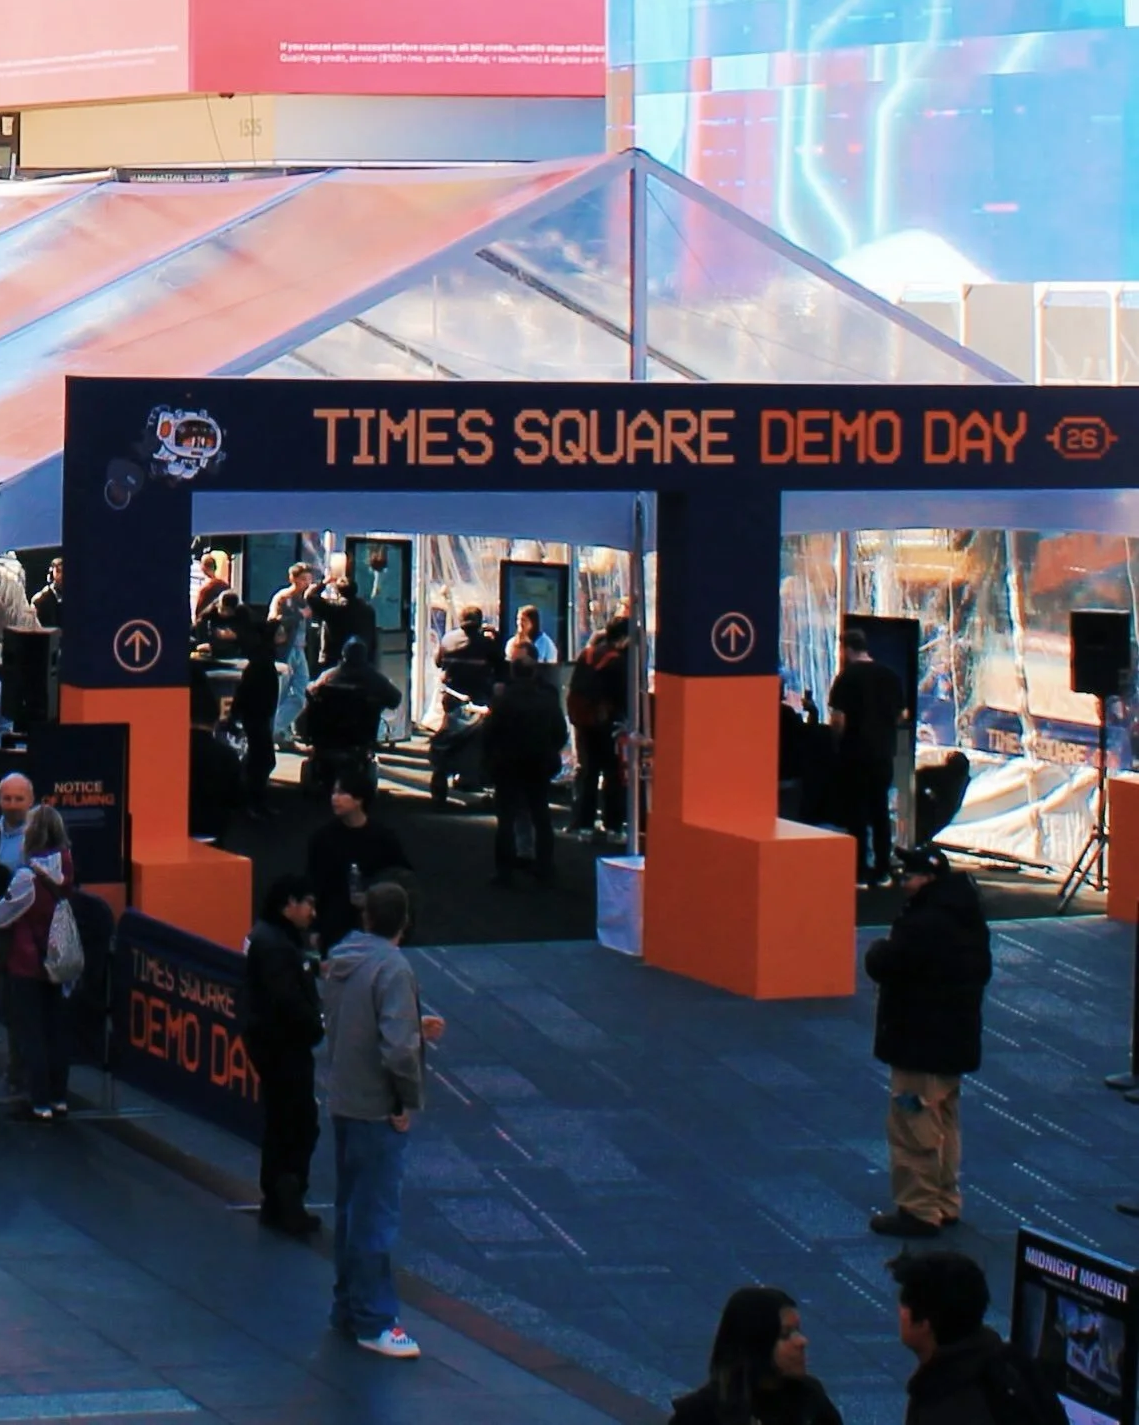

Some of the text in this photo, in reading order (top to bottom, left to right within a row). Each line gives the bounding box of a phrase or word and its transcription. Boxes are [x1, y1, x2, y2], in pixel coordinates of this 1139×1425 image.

[315, 409, 493, 465] TIMES
[514, 409, 735, 465] SQUARE
[760, 411, 903, 465] DEMO
[924, 412, 1028, 465] DAY
[54, 781, 103, 794] NOTICE
[62, 793, 115, 806] FILMING
[132, 947, 237, 1019] TIMES SQUARE
[131, 989, 201, 1073] DEMO
[1025, 1245, 1078, 1282] MIDNIGHT
[1079, 1267, 1128, 1303] MOMENT
